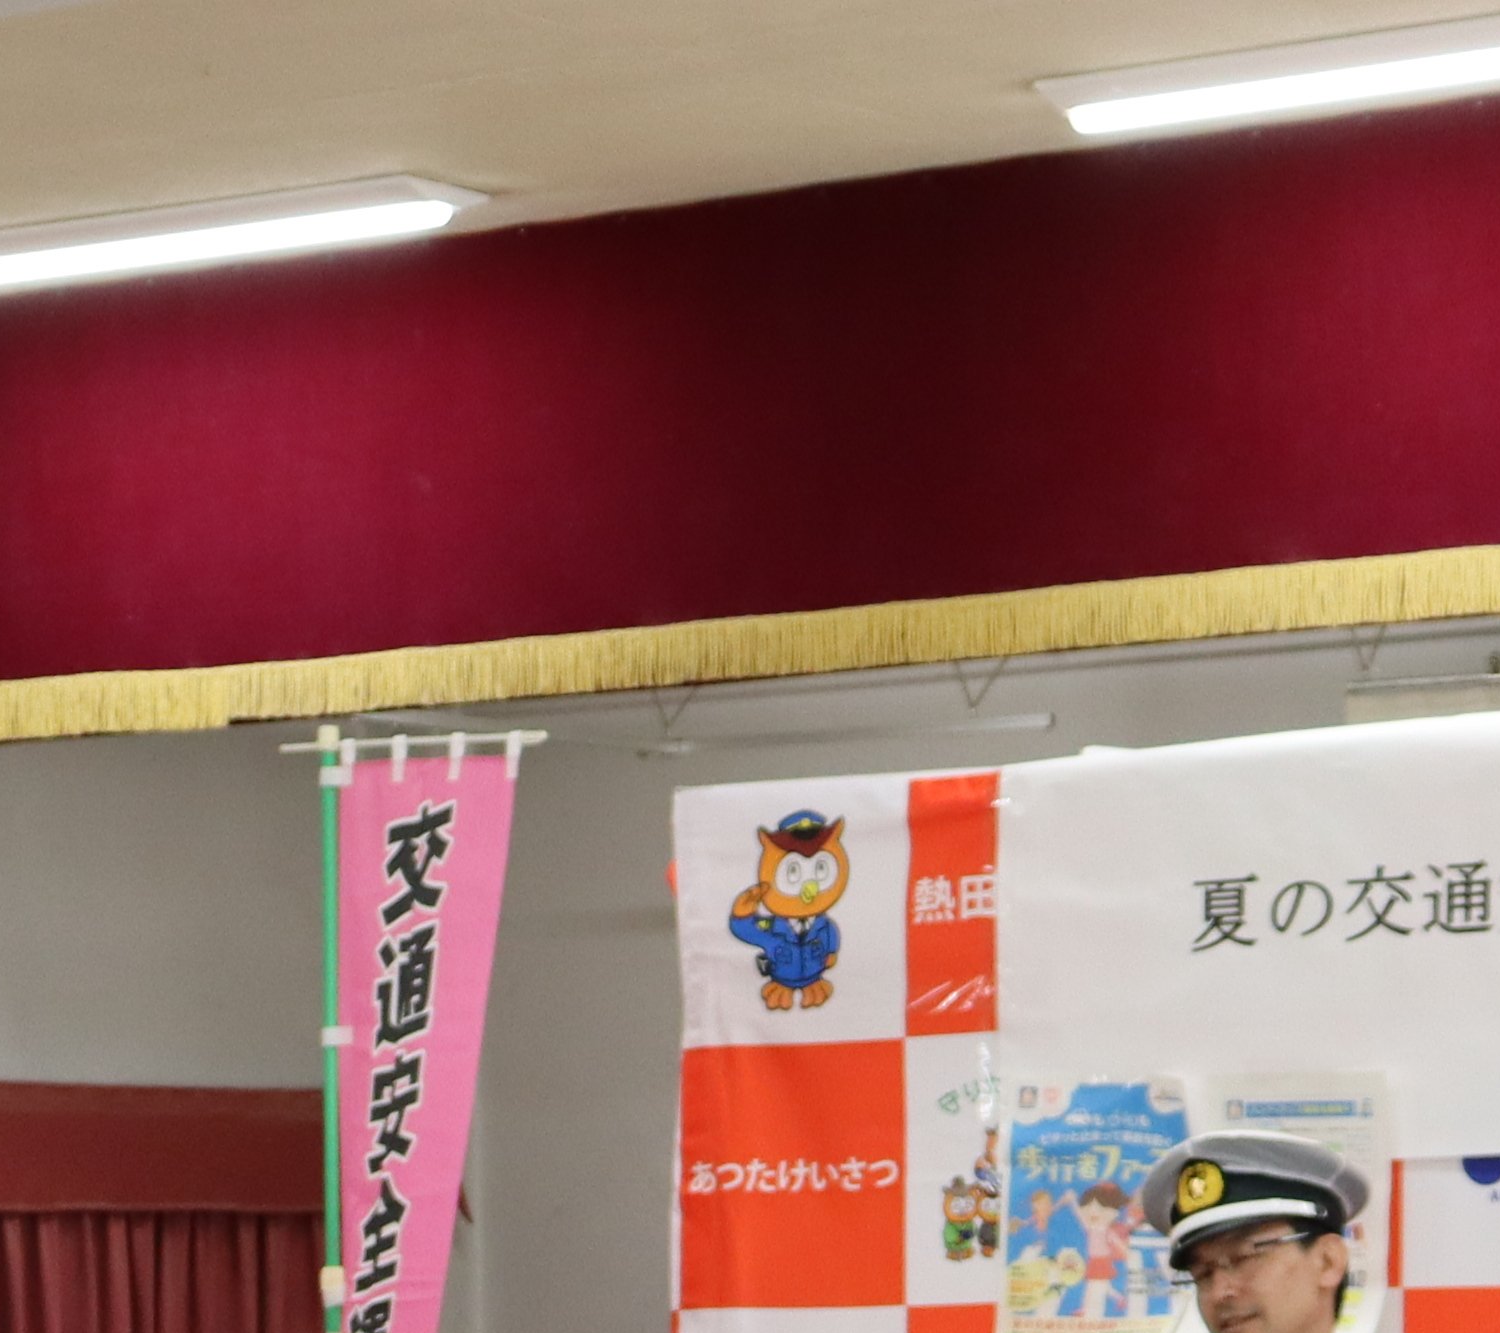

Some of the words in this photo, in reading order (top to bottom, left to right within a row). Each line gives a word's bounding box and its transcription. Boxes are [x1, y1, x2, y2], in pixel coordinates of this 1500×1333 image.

[913, 873, 1000, 923] 熱田
[687, 1156, 900, 1194] あつたけいさつ
